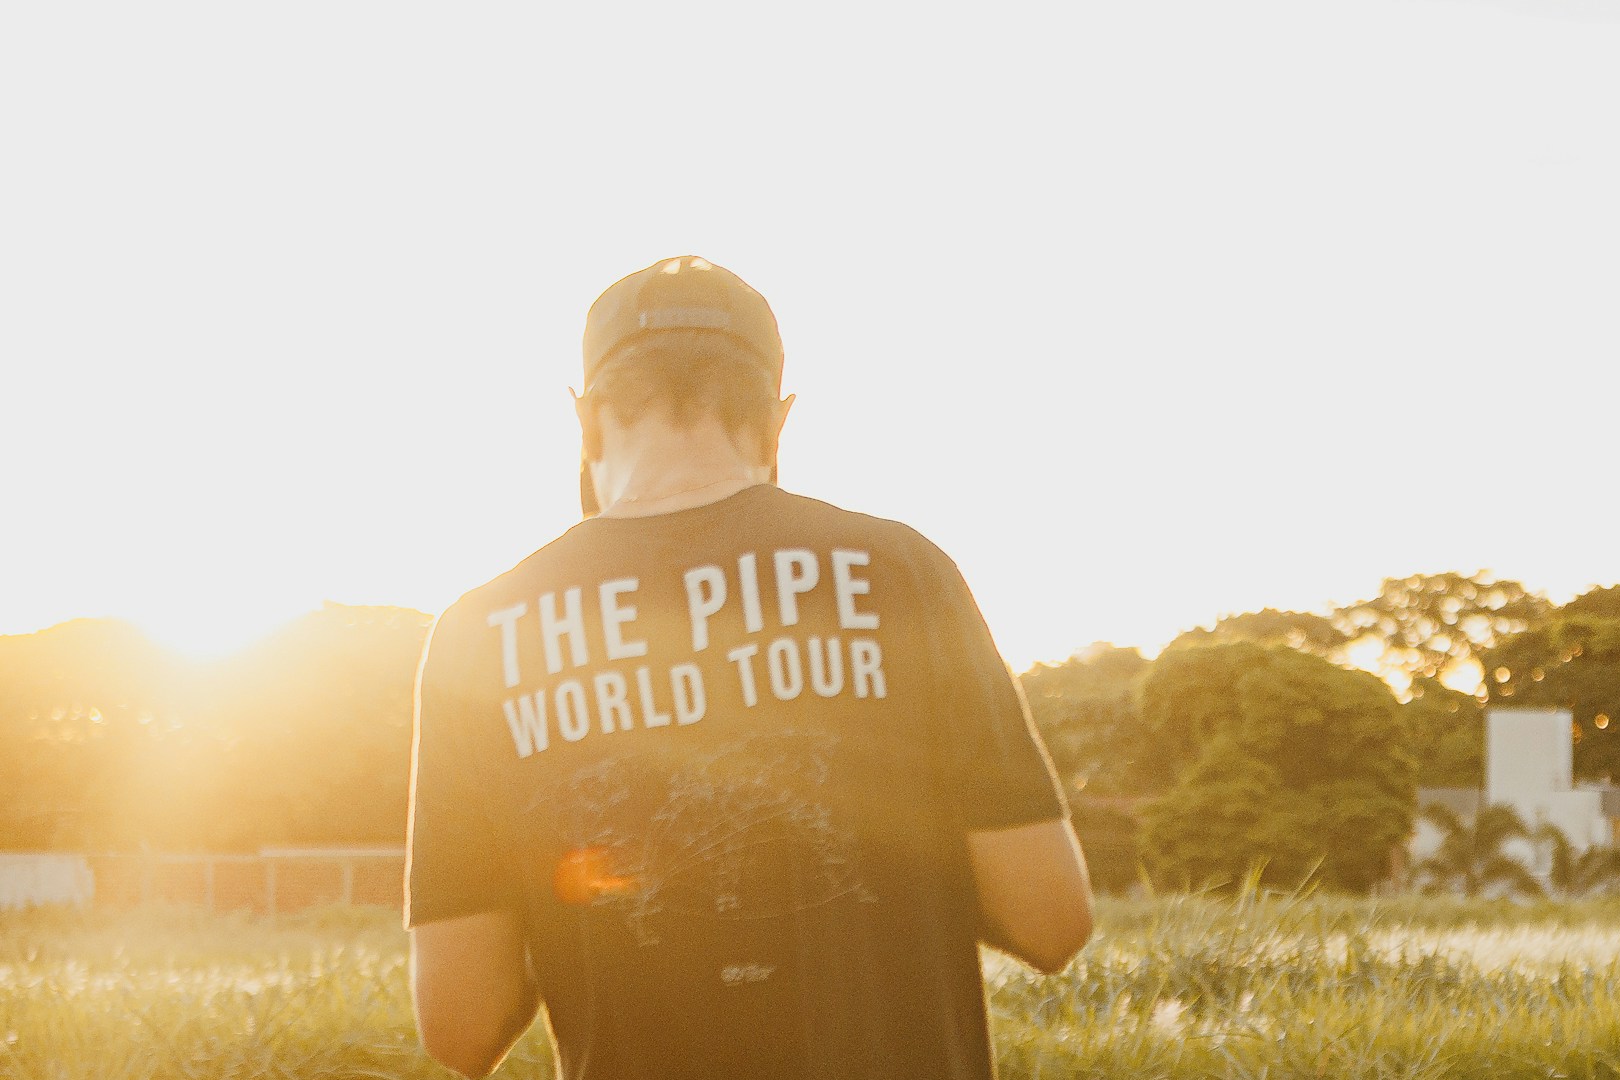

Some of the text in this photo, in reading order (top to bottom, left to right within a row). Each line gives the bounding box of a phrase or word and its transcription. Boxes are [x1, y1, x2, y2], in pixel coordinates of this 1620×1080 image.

[487, 548, 881, 690] THE PIPE
[502, 637, 888, 759] WORLD TOUR
